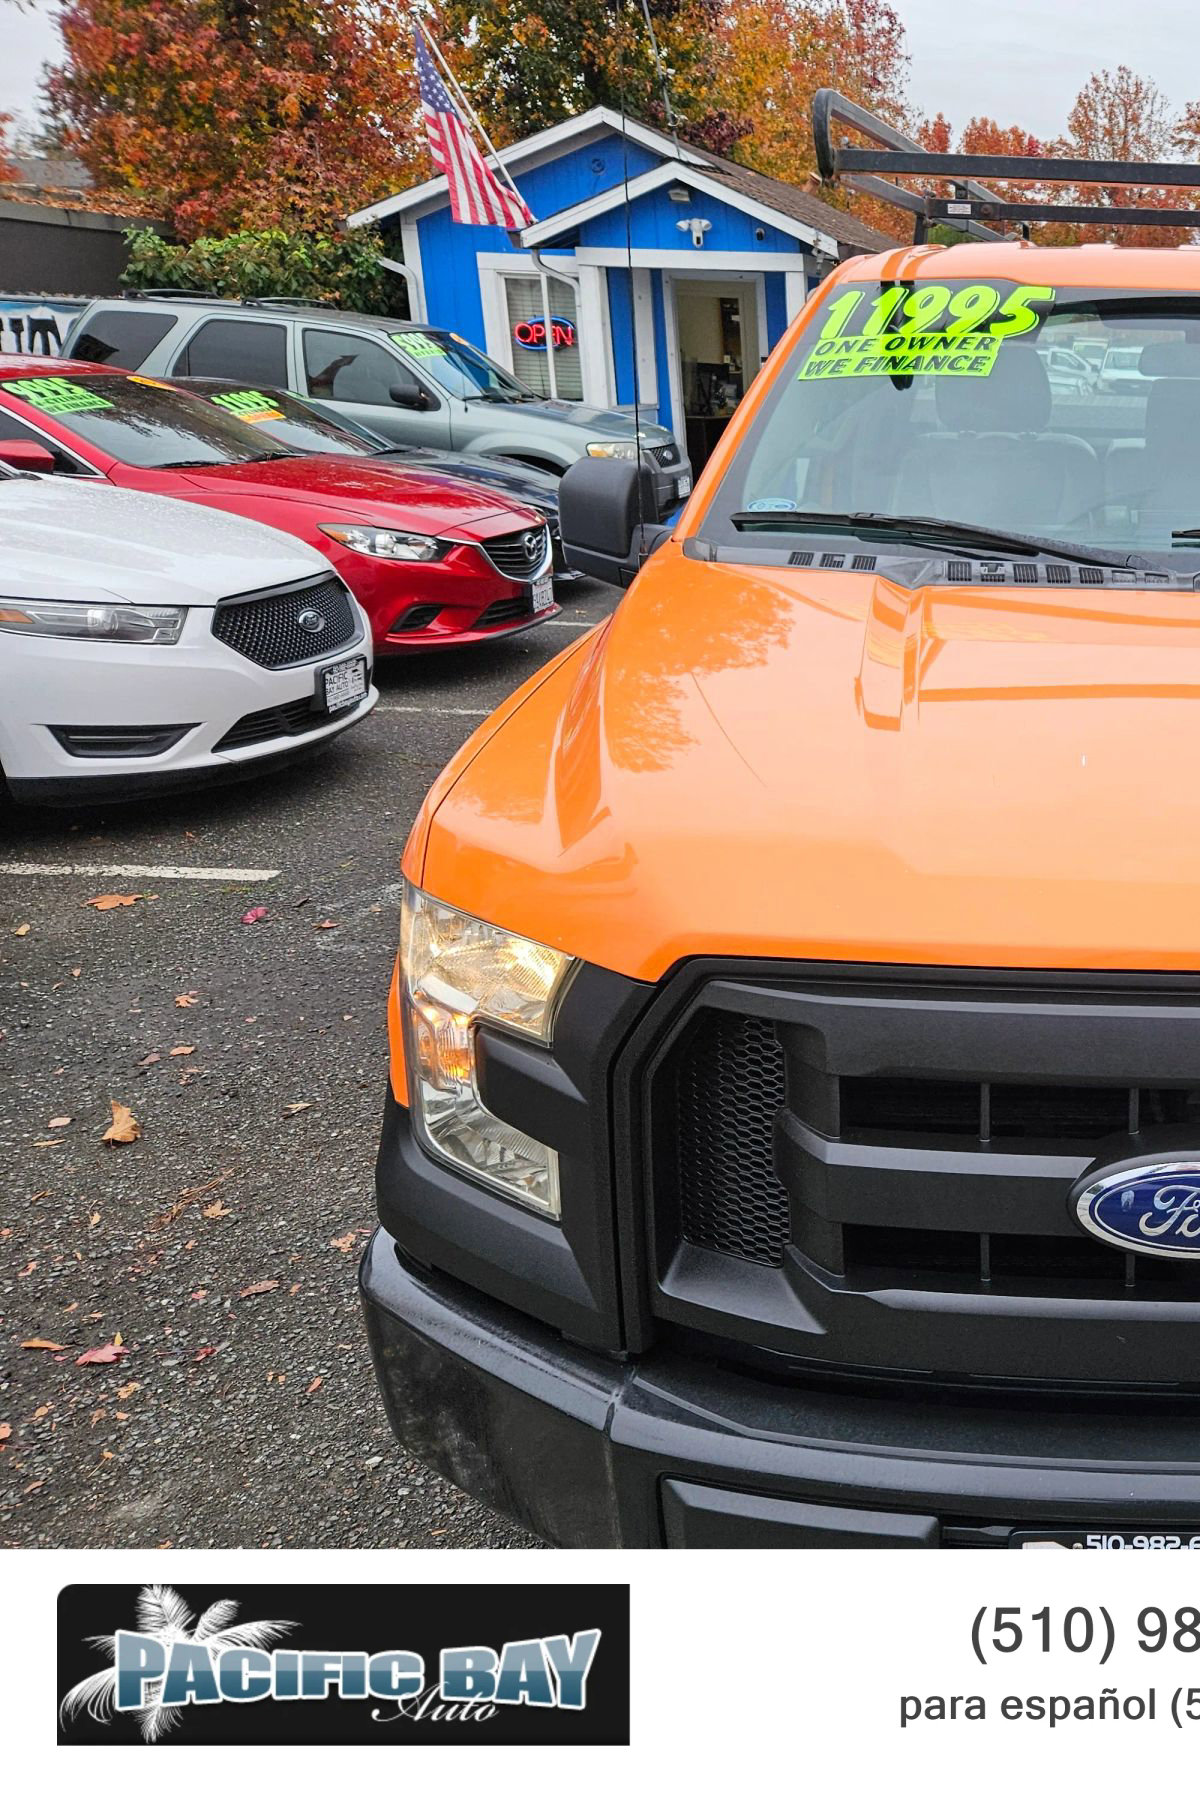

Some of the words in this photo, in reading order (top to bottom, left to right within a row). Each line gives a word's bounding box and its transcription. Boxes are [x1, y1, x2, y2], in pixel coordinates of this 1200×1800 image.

[820, 285, 1056, 338] 11995
[515, 323, 574, 345] OPN
[814, 337, 877, 356] ONE
[884, 336, 998, 352] OWNER
[804, 358, 852, 377] WE
[853, 355, 991, 374] FINANCE
[1, 377, 89, 400] 9995
